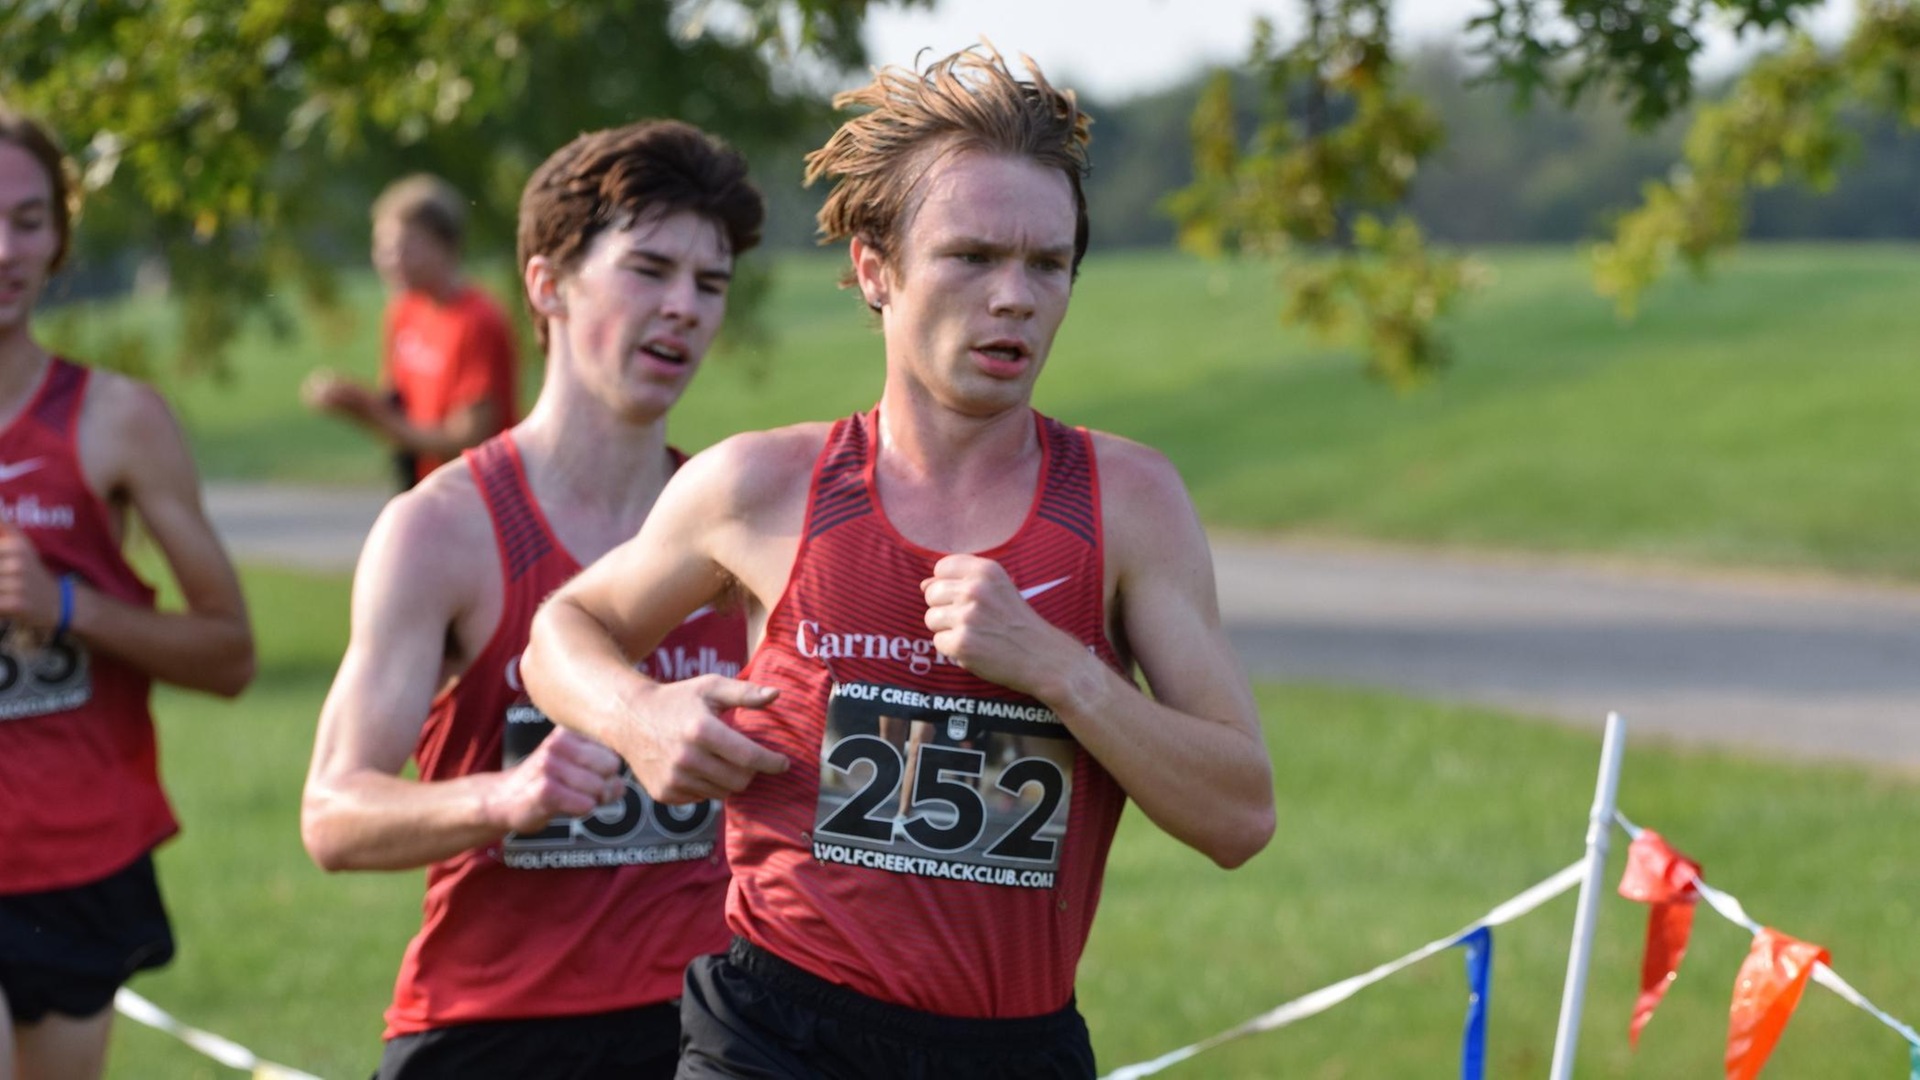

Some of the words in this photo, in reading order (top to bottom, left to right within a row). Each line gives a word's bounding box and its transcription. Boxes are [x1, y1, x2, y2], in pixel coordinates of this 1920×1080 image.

[796, 619, 956, 675] Carneg
[881, 688, 931, 708] CREEK
[933, 696, 975, 714] RACE
[977, 701, 1062, 724] MANAGEM
[815, 734, 1065, 864] 252
[813, 842, 1054, 888] WOLFCREEKTRACKCLUB.COM
